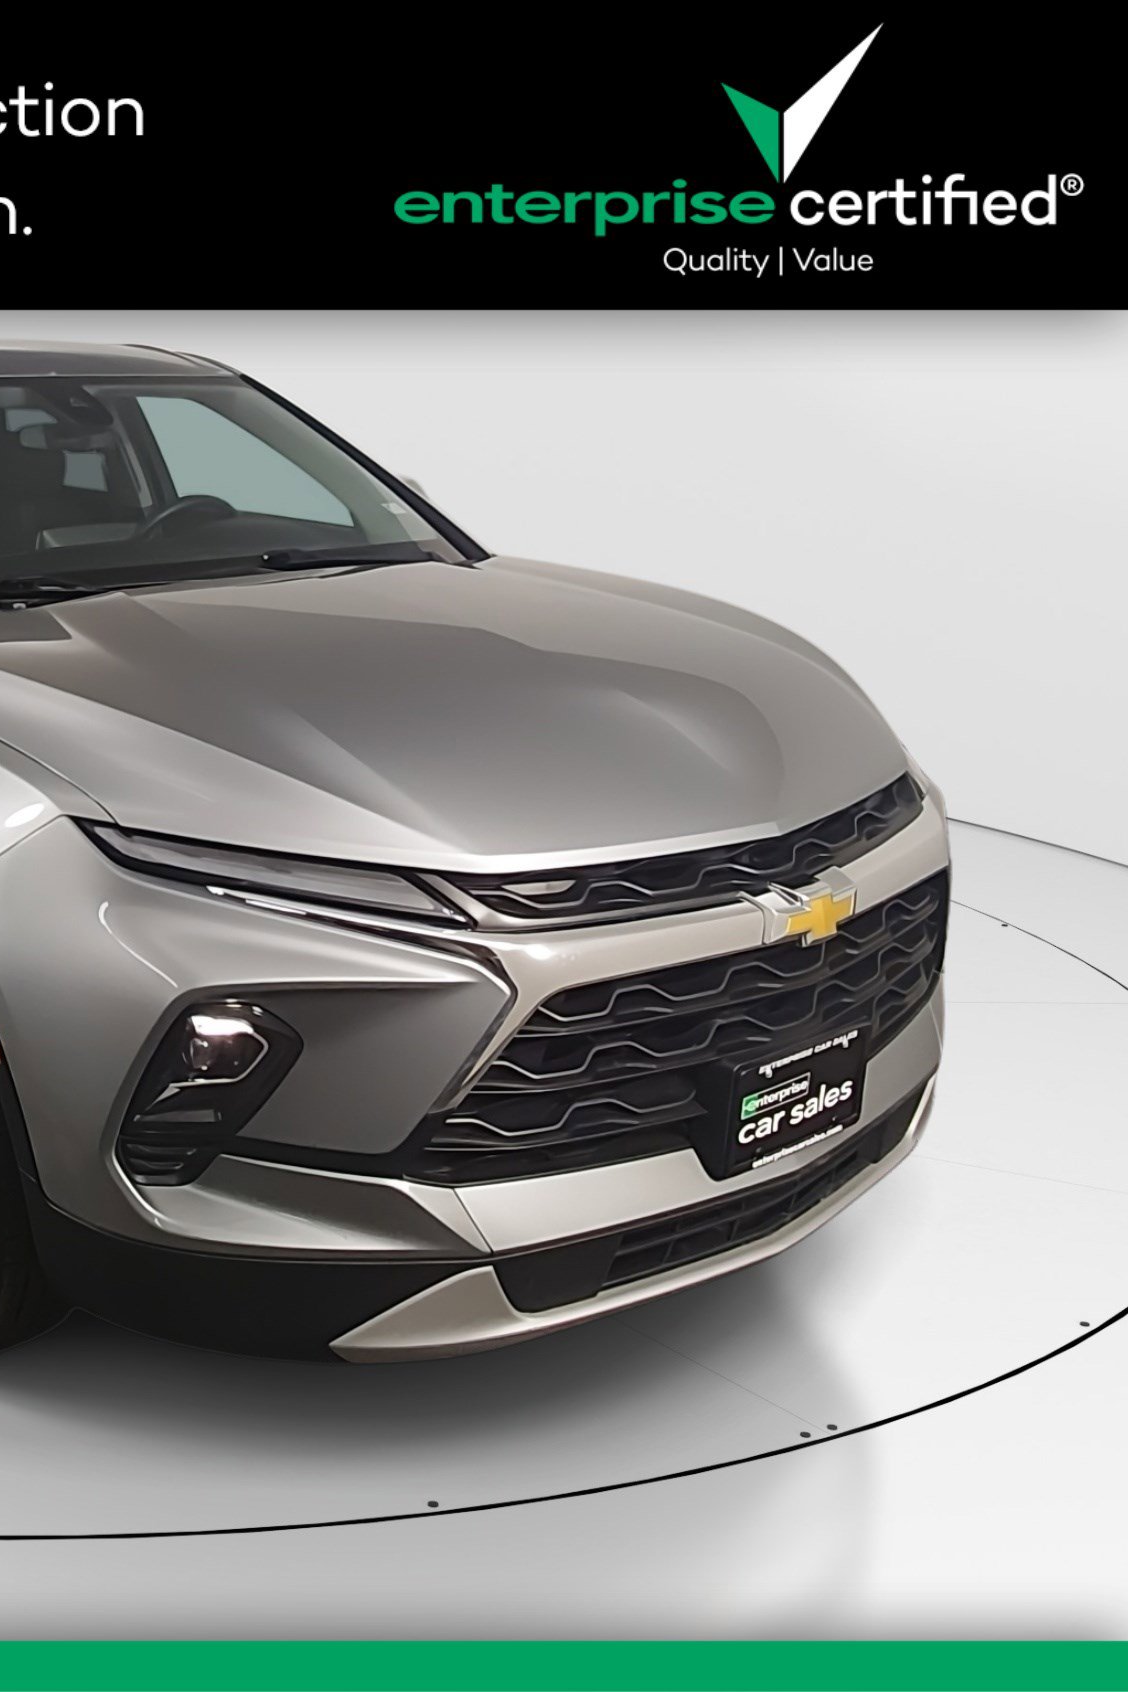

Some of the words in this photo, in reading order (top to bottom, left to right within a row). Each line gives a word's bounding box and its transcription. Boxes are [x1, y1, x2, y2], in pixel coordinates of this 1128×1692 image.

[738, 1110, 786, 1144] car
[789, 1080, 853, 1125] sales
[746, 1080, 809, 1112] enterprise
